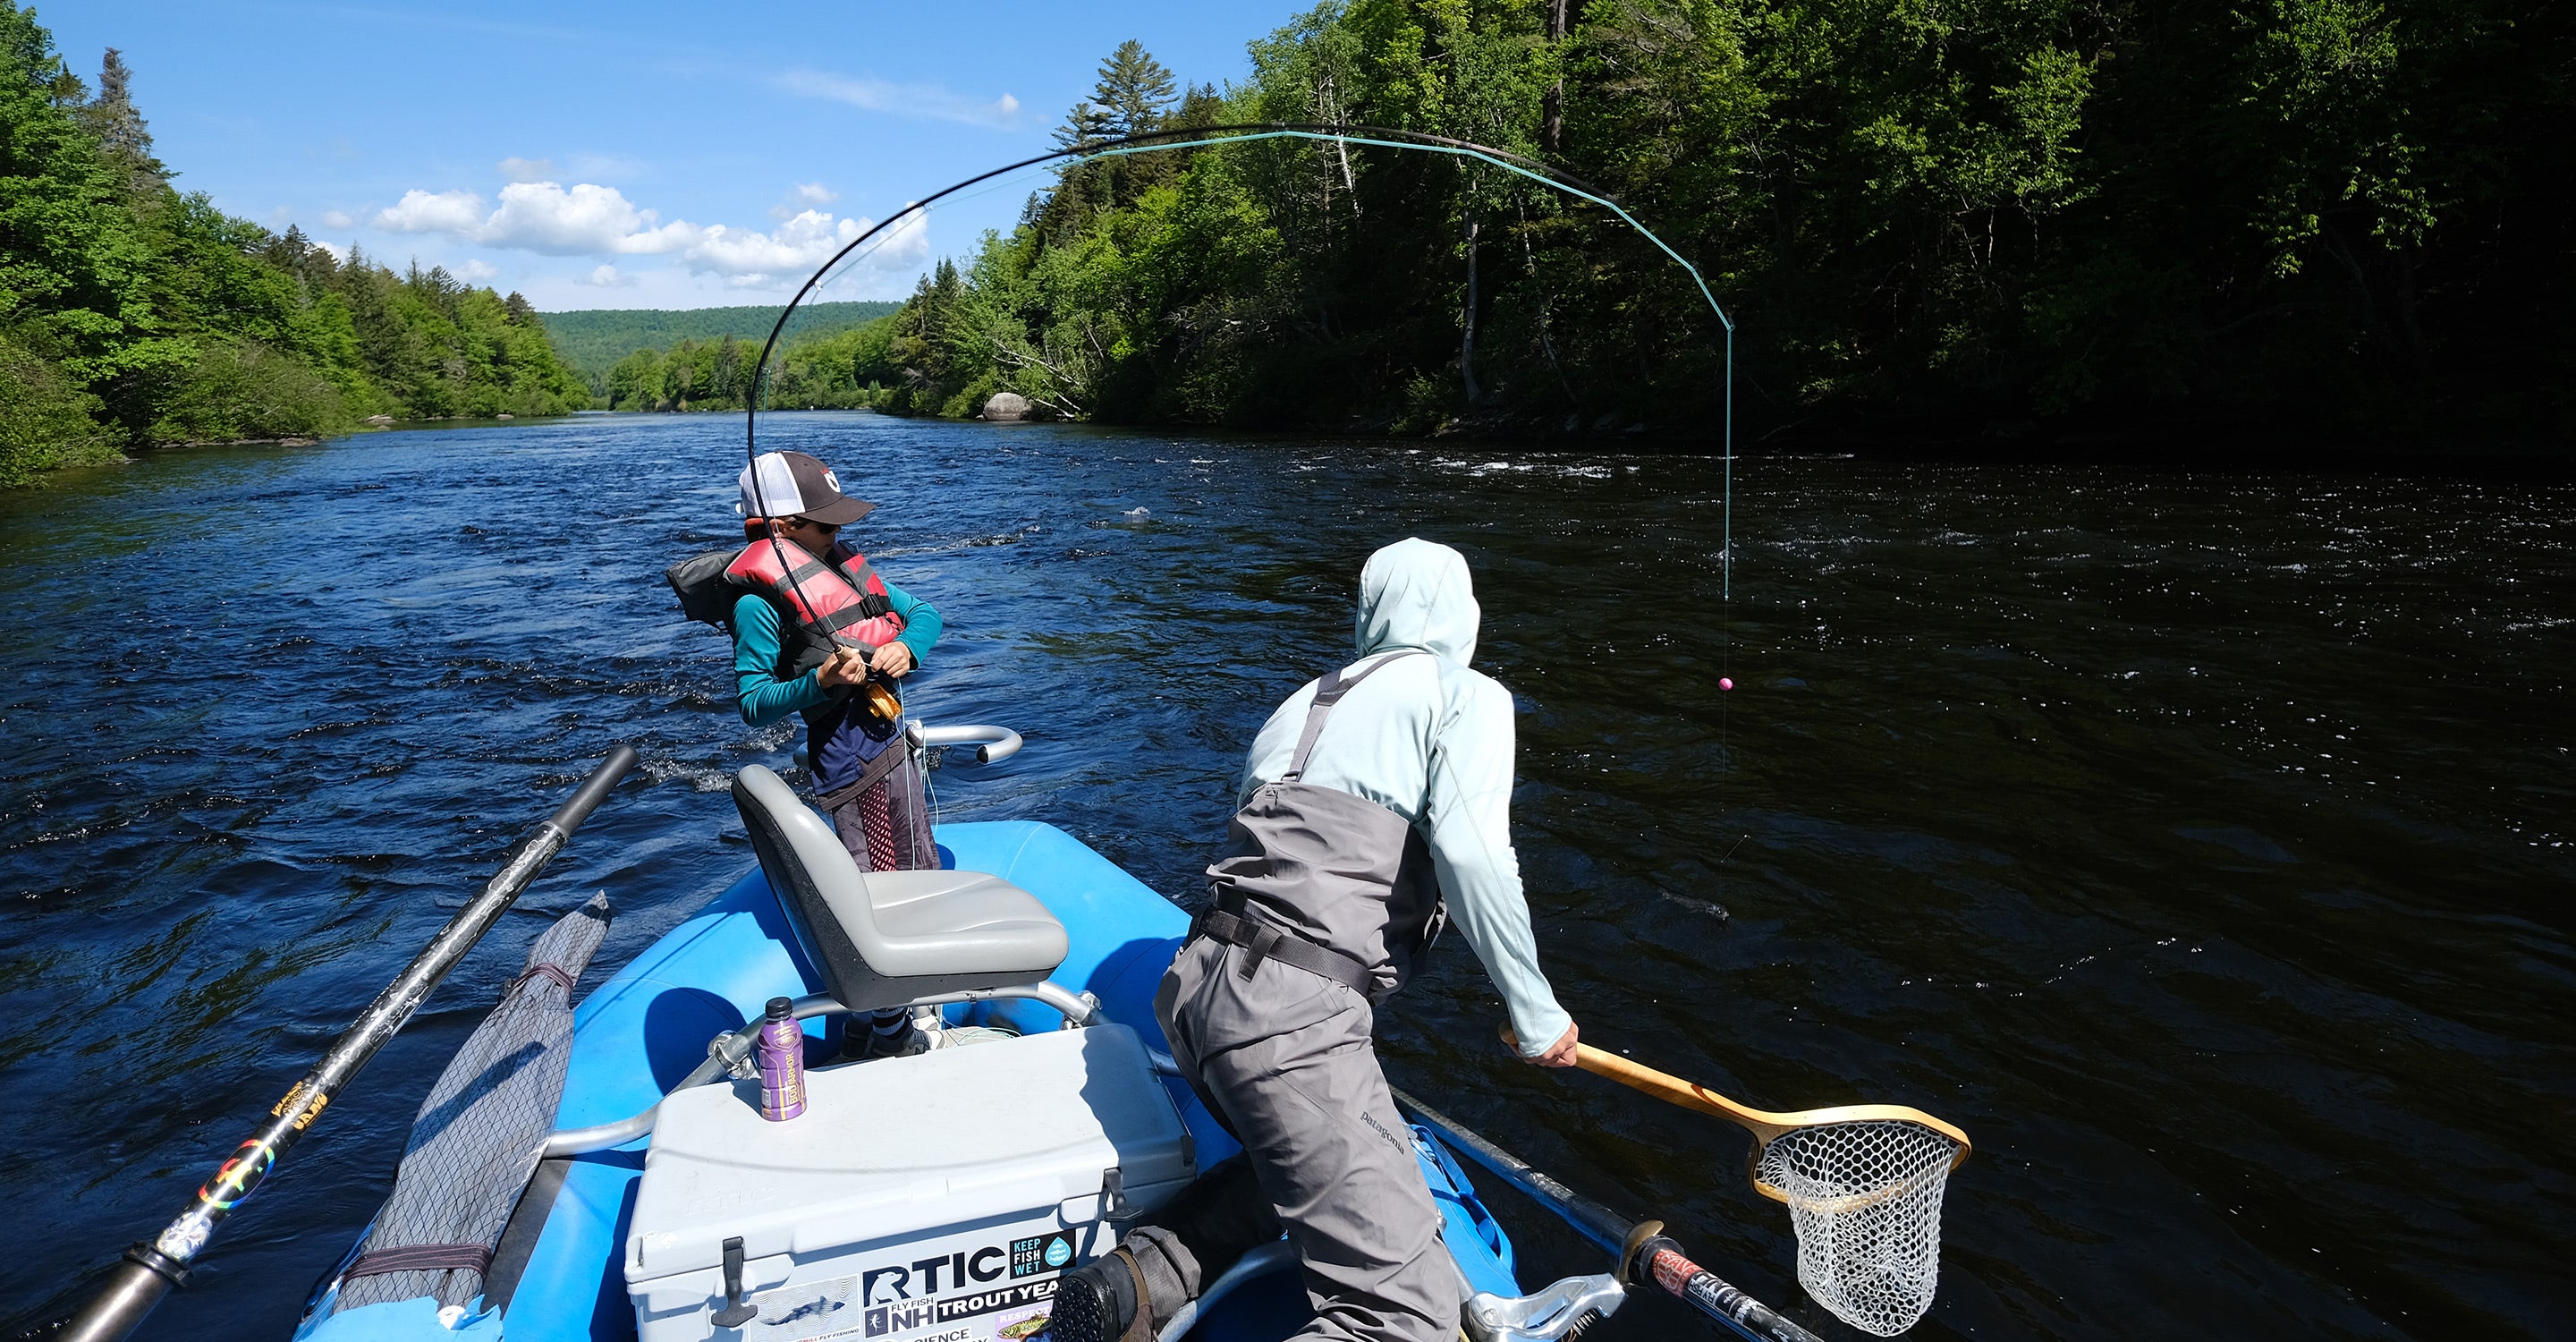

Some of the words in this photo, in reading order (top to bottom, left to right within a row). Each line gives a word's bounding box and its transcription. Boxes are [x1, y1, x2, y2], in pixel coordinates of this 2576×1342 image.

[1360, 1110, 1404, 1156] patagonia
[1013, 1237, 1041, 1253] KEEP
[1013, 1250, 1041, 1265] FISH
[862, 1246, 1007, 1308] RTIC
[1014, 1261, 1041, 1277] WET
[891, 1301, 909, 1312] FLY
[911, 1296, 935, 1308] FISH
[938, 1290, 1016, 1317] TROUT
[1017, 1280, 1059, 1301] YEA
[892, 1305, 934, 1333] NH
[999, 1306, 1051, 1324] RESPECT
[833, 1329, 860, 1338] FISHING
